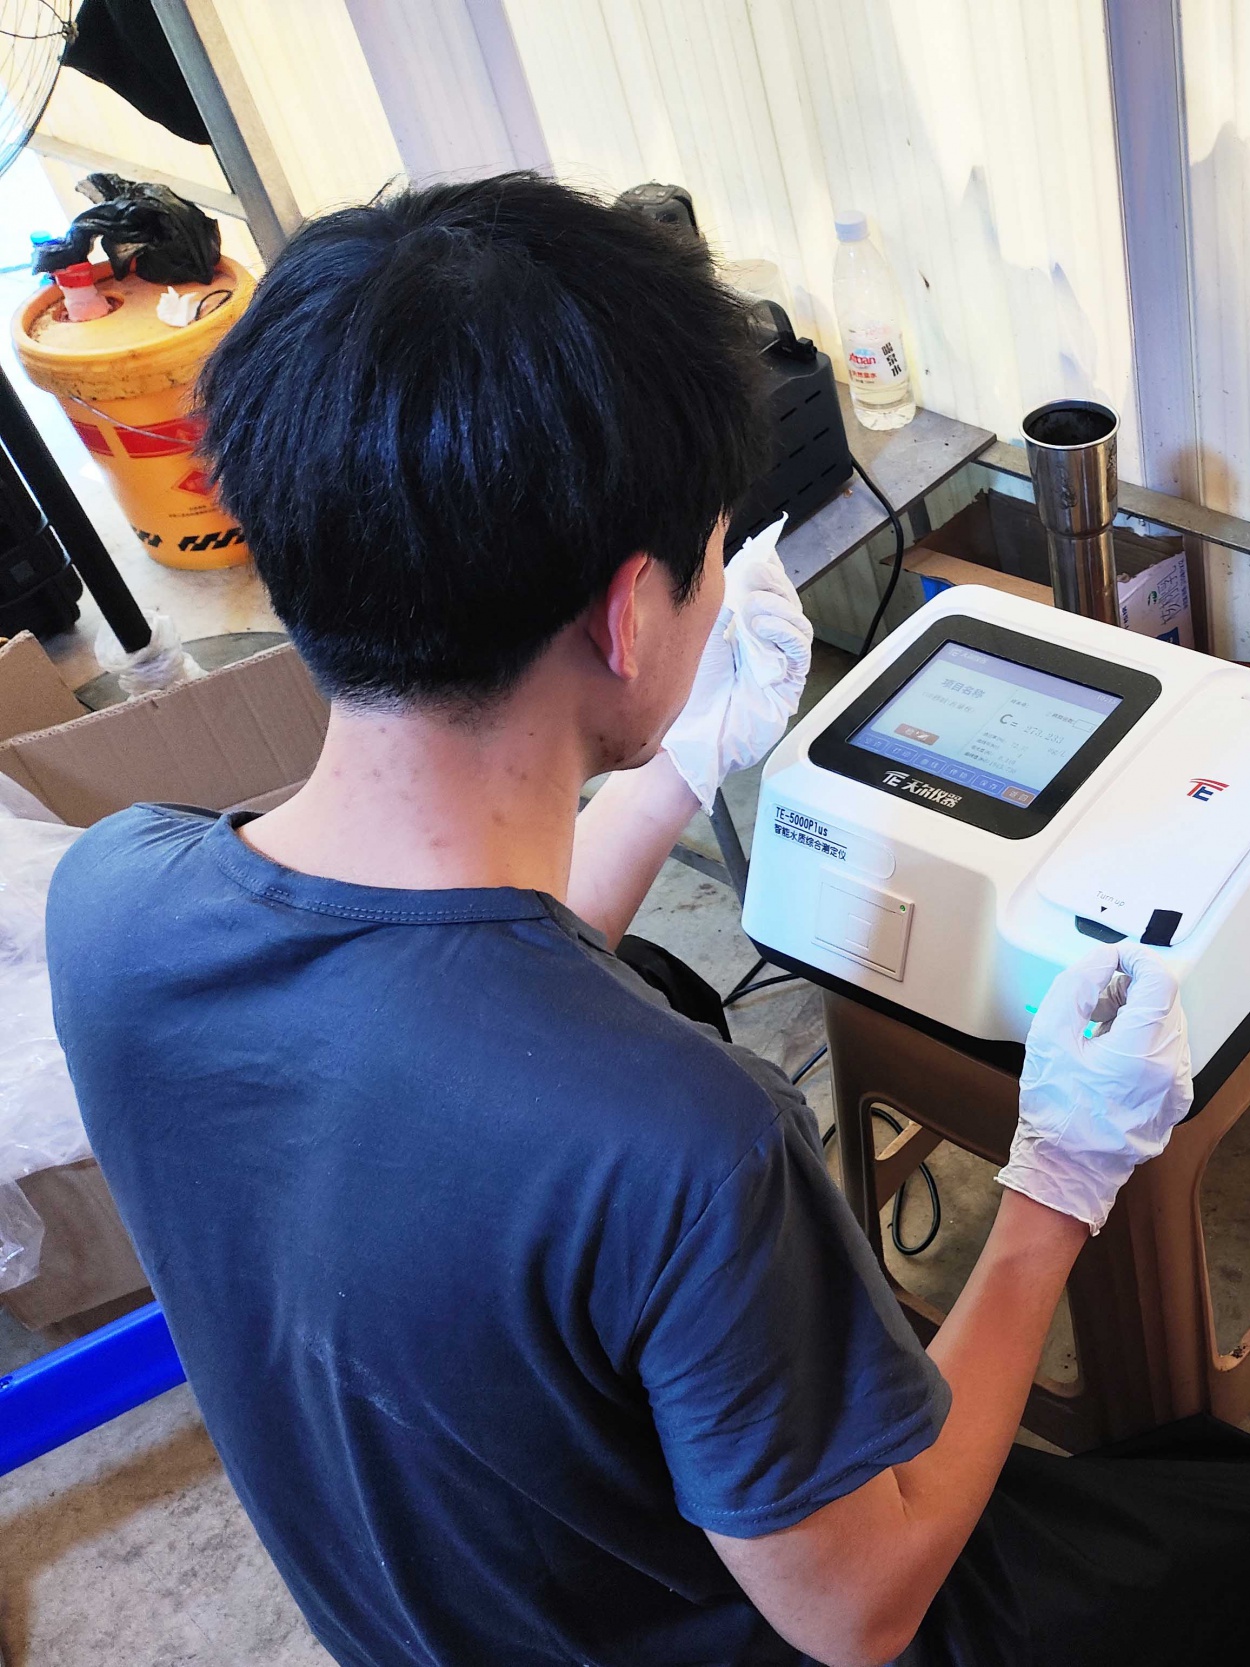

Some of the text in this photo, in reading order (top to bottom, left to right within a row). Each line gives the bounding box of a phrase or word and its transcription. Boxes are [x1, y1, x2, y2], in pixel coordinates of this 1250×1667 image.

[901, 778, 963, 809] 天尔仪器
[775, 806, 828, 837] TE-5000Plus
[774, 823, 847, 862] 智能水质综合测定仪
[1096, 890, 1126, 907] Turn up
